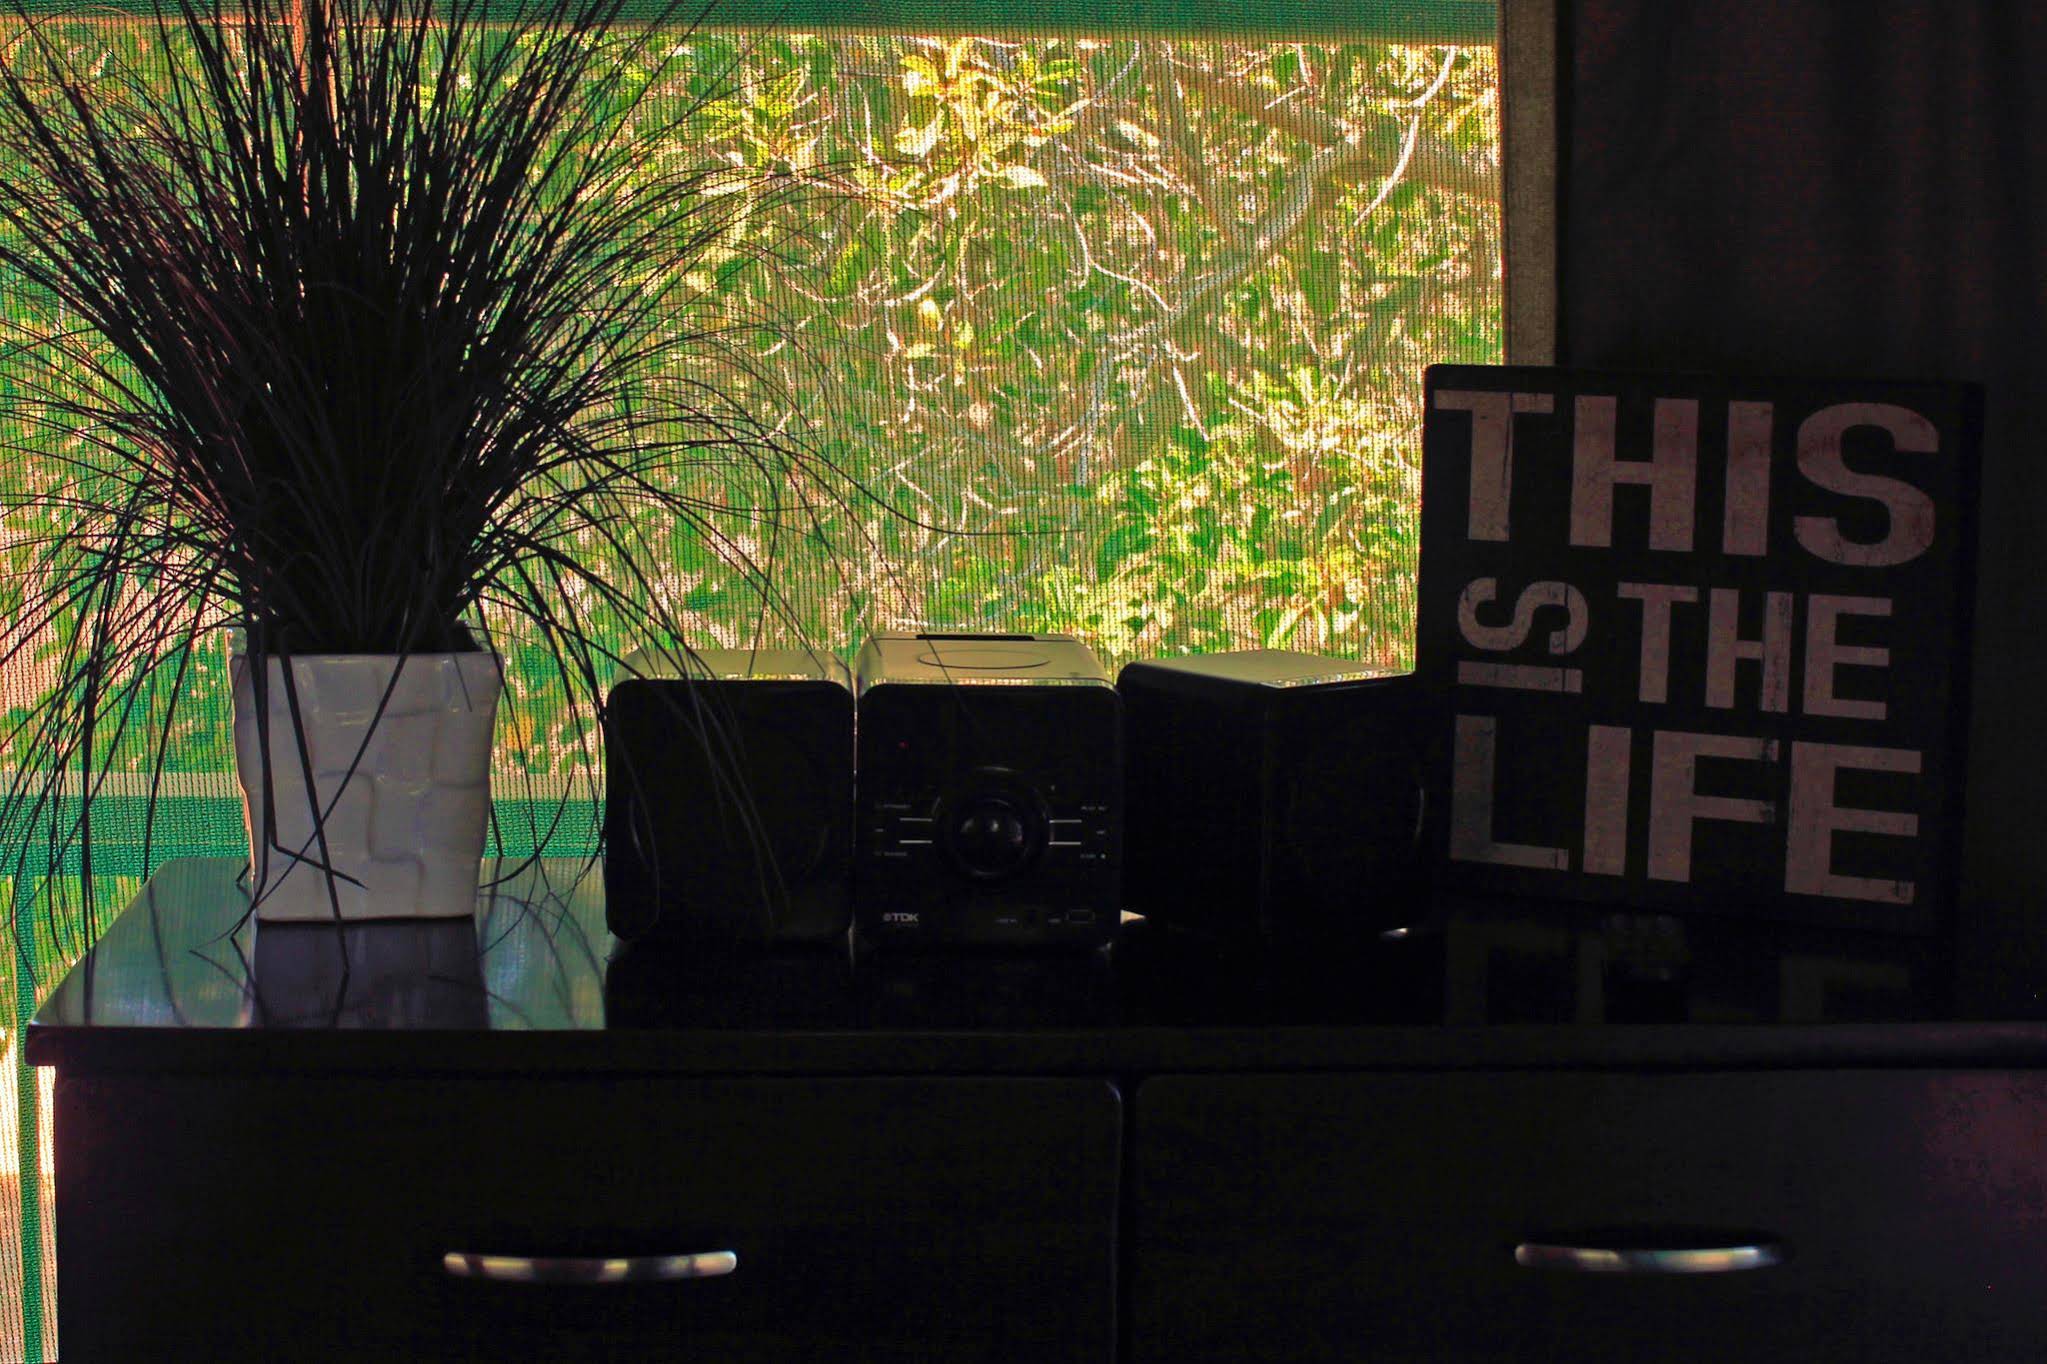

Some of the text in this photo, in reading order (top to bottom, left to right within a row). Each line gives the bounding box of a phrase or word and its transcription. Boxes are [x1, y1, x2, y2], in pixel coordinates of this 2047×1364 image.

[1433, 389, 1940, 567] THIS
[1457, 577, 1893, 721] IS THE
[1449, 713, 1922, 906] LIFE
[893, 912, 920, 923] TDK
